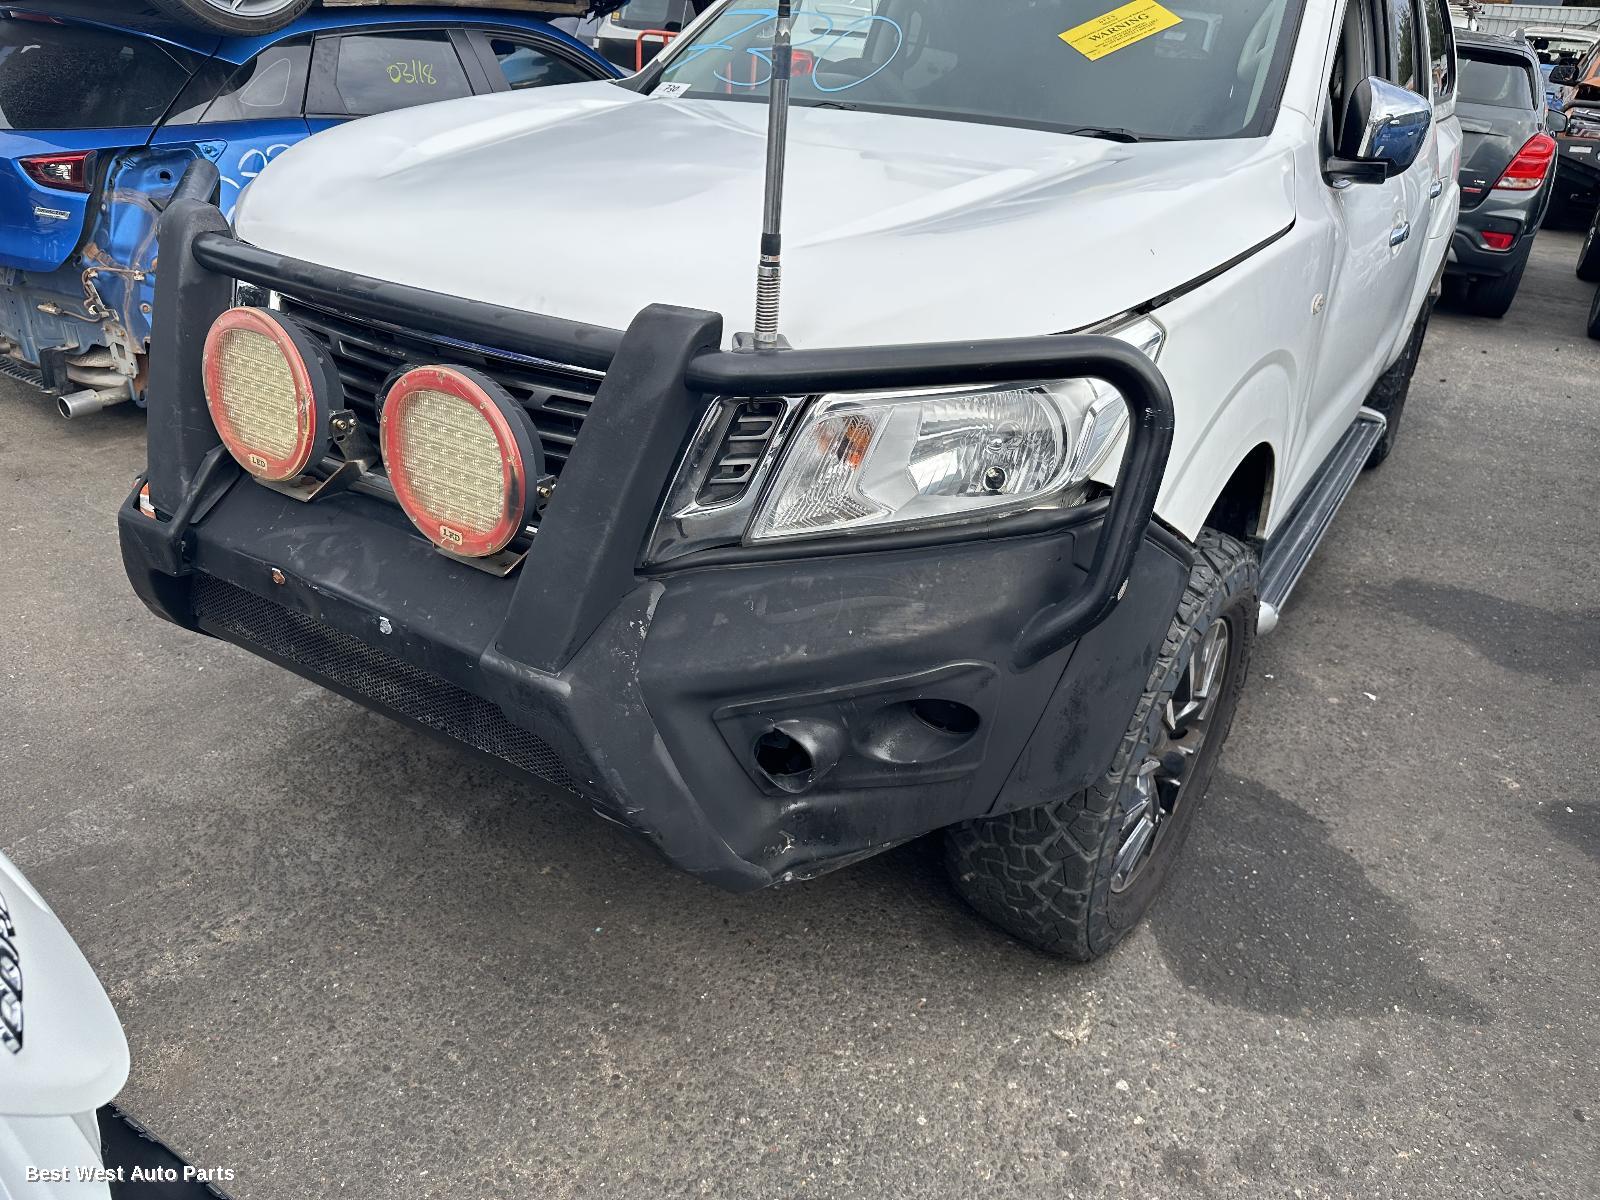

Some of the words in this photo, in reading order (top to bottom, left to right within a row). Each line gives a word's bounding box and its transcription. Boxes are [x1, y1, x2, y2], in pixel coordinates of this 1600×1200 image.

[1088, 12, 1149, 42] WARNING
[251, 456, 266, 468] LED
[443, 528, 460, 542] LED
